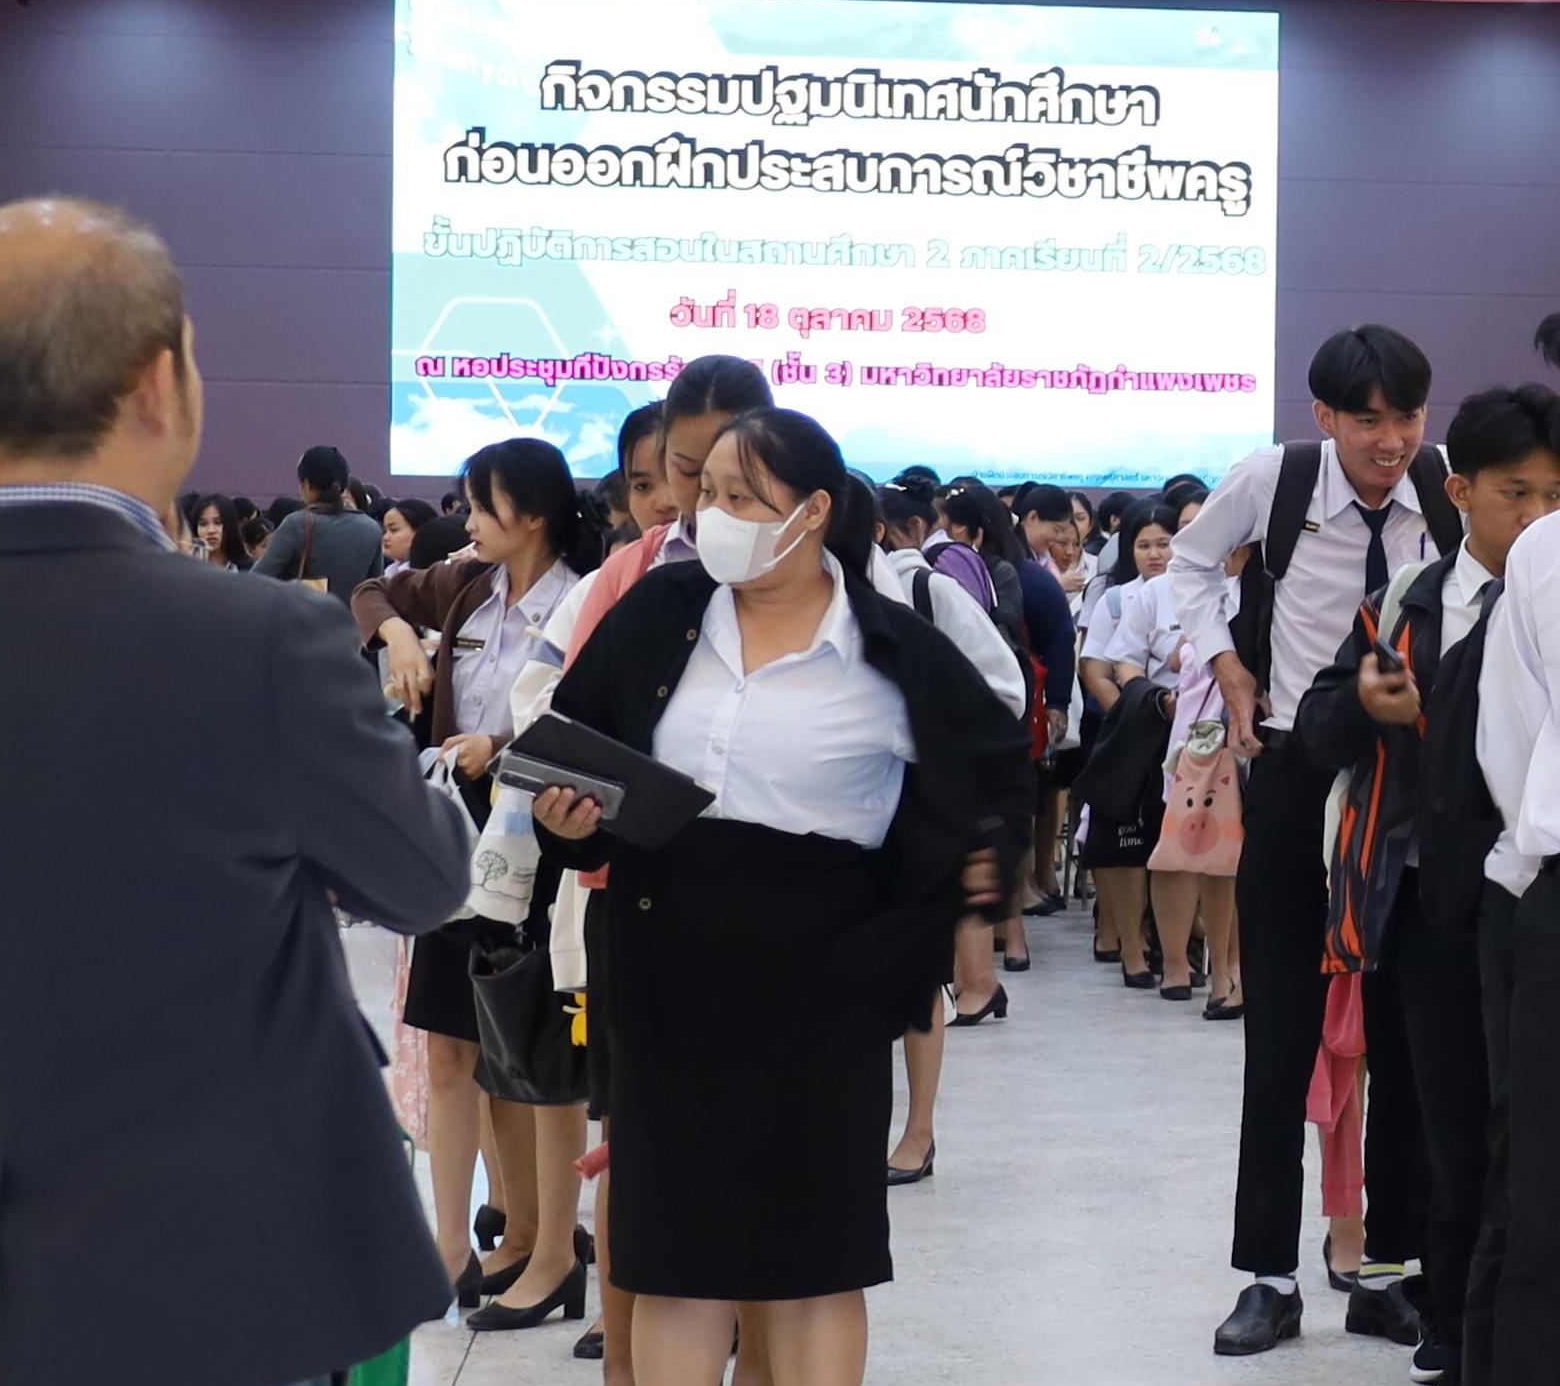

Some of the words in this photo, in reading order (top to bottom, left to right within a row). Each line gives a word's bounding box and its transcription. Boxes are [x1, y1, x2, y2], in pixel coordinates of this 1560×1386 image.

[540, 59, 1160, 126] กิจกรรมปฐมนิเทศนักศึกษา
[444, 126, 1252, 217] ก่อนออกฝึกประสบการณ์วิชาชีพครู
[423, 215, 915, 267] ขั้นปฏิบัติการสอนในสถานศึกษา
[926, 239, 951, 268] 2
[960, 232, 1127, 271] ภาคเรียนที่
[1137, 243, 1267, 276] 2/2568
[669, 289, 736, 328] วันที่
[743, 303, 780, 329] 18
[787, 307, 893, 339] ตุลาคม
[901, 306, 987, 334] 2568
[415, 356, 446, 378] ณ
[771, 351, 817, 386] (ชั้น
[824, 360, 853, 387] 3)
[860, 362, 1257, 395] มหาวิทยาลัยราชภัฏกำแพงเพชร
